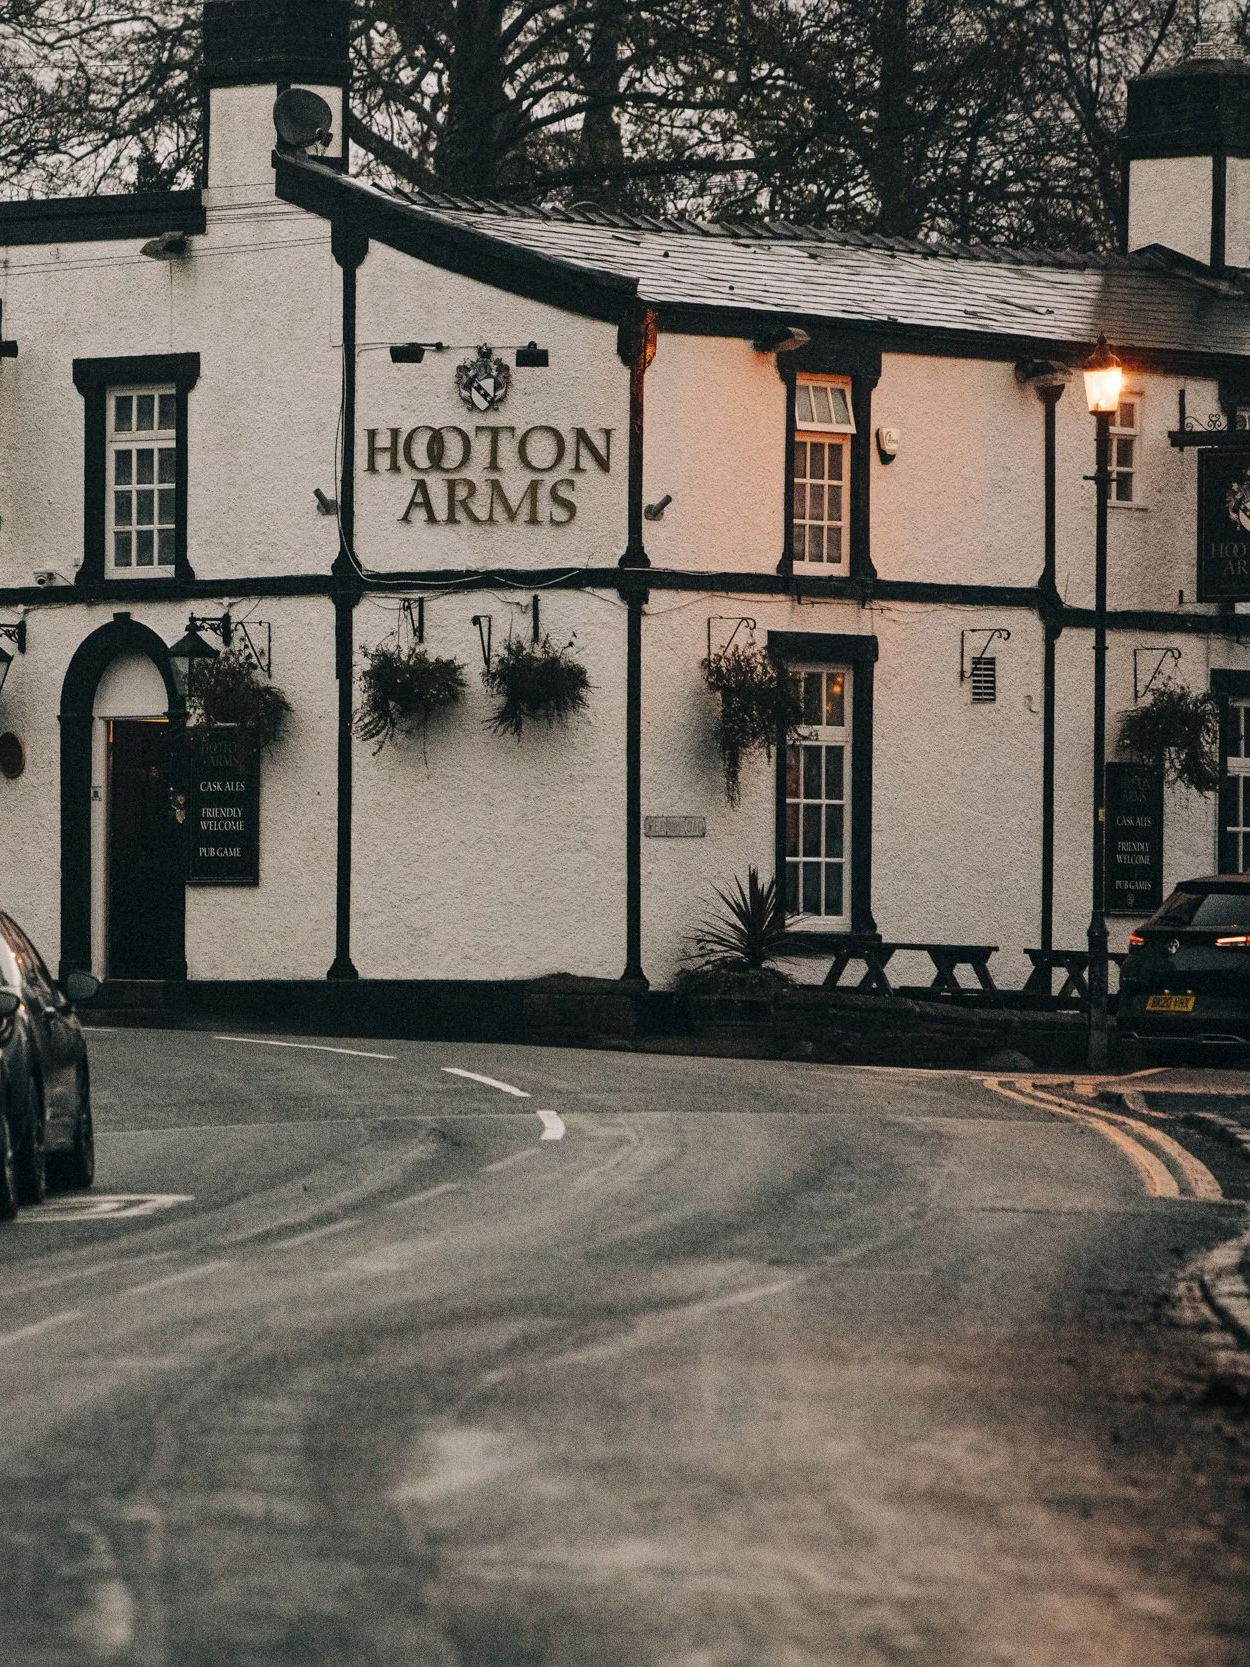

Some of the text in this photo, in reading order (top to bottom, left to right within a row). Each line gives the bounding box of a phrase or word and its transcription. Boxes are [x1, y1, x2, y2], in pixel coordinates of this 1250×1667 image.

[362, 425, 616, 473] HOOTON
[397, 478, 577, 524] ARMS
[200, 781, 246, 792] CASK ALES
[201, 807, 243, 818] FRIENDLY
[200, 820, 245, 831] WELCOME
[1116, 816, 1152, 826] CASK ALES
[199, 847, 242, 857] PUB GAME
[1117, 841, 1150, 852] FRIENDLY
[1116, 854, 1151, 865] WELCOME
[1115, 880, 1152, 890] PUB GAMES
